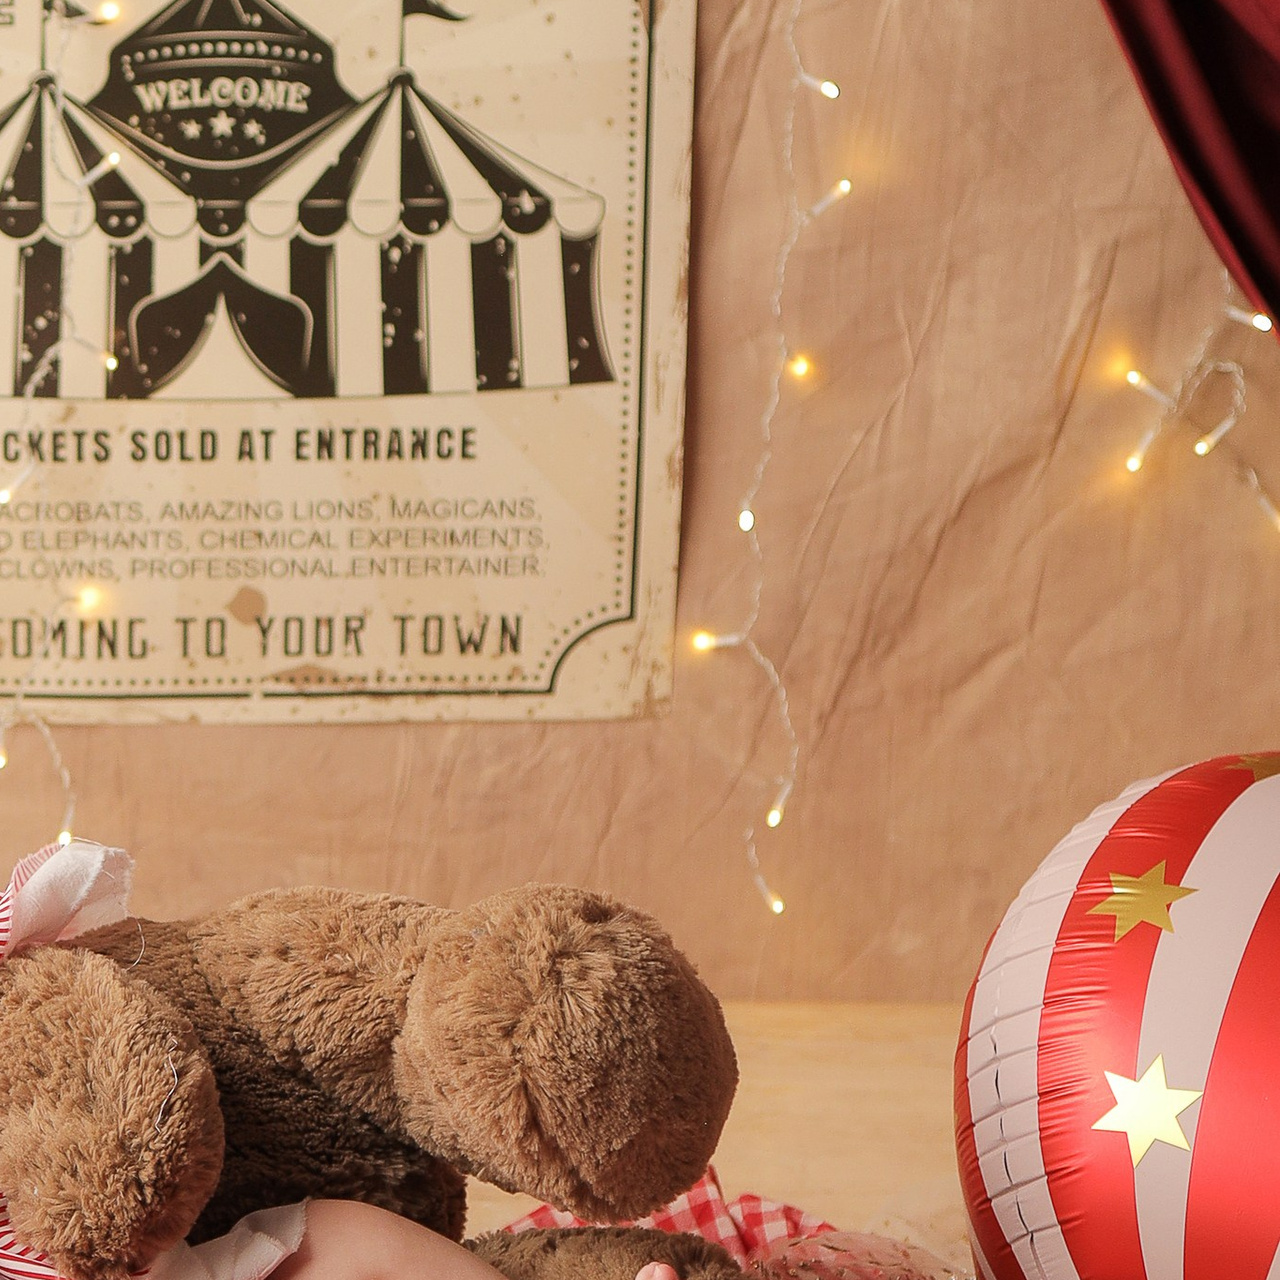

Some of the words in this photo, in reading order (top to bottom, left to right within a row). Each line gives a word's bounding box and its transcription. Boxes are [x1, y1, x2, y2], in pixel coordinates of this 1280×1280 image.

[133, 76, 312, 114] WELCOME
[130, 429, 218, 462] SOLD
[238, 428, 276, 461] AT
[295, 426, 477, 461] ENTRANCE
[160, 500, 284, 523] AMAZING
[293, 499, 381, 523] LIONS,
[391, 496, 543, 522] MAGICANS,
[22, 531, 190, 553] ELEPHANTS,
[199, 529, 339, 552] CHEMICAL
[350, 527, 551, 552] EXPERIMENTS,
[131, 557, 339, 581] PROFESSIONAL
[176, 616, 226, 658] TO
[256, 615, 366, 658] YOUR
[394, 614, 522, 657] TOWN
